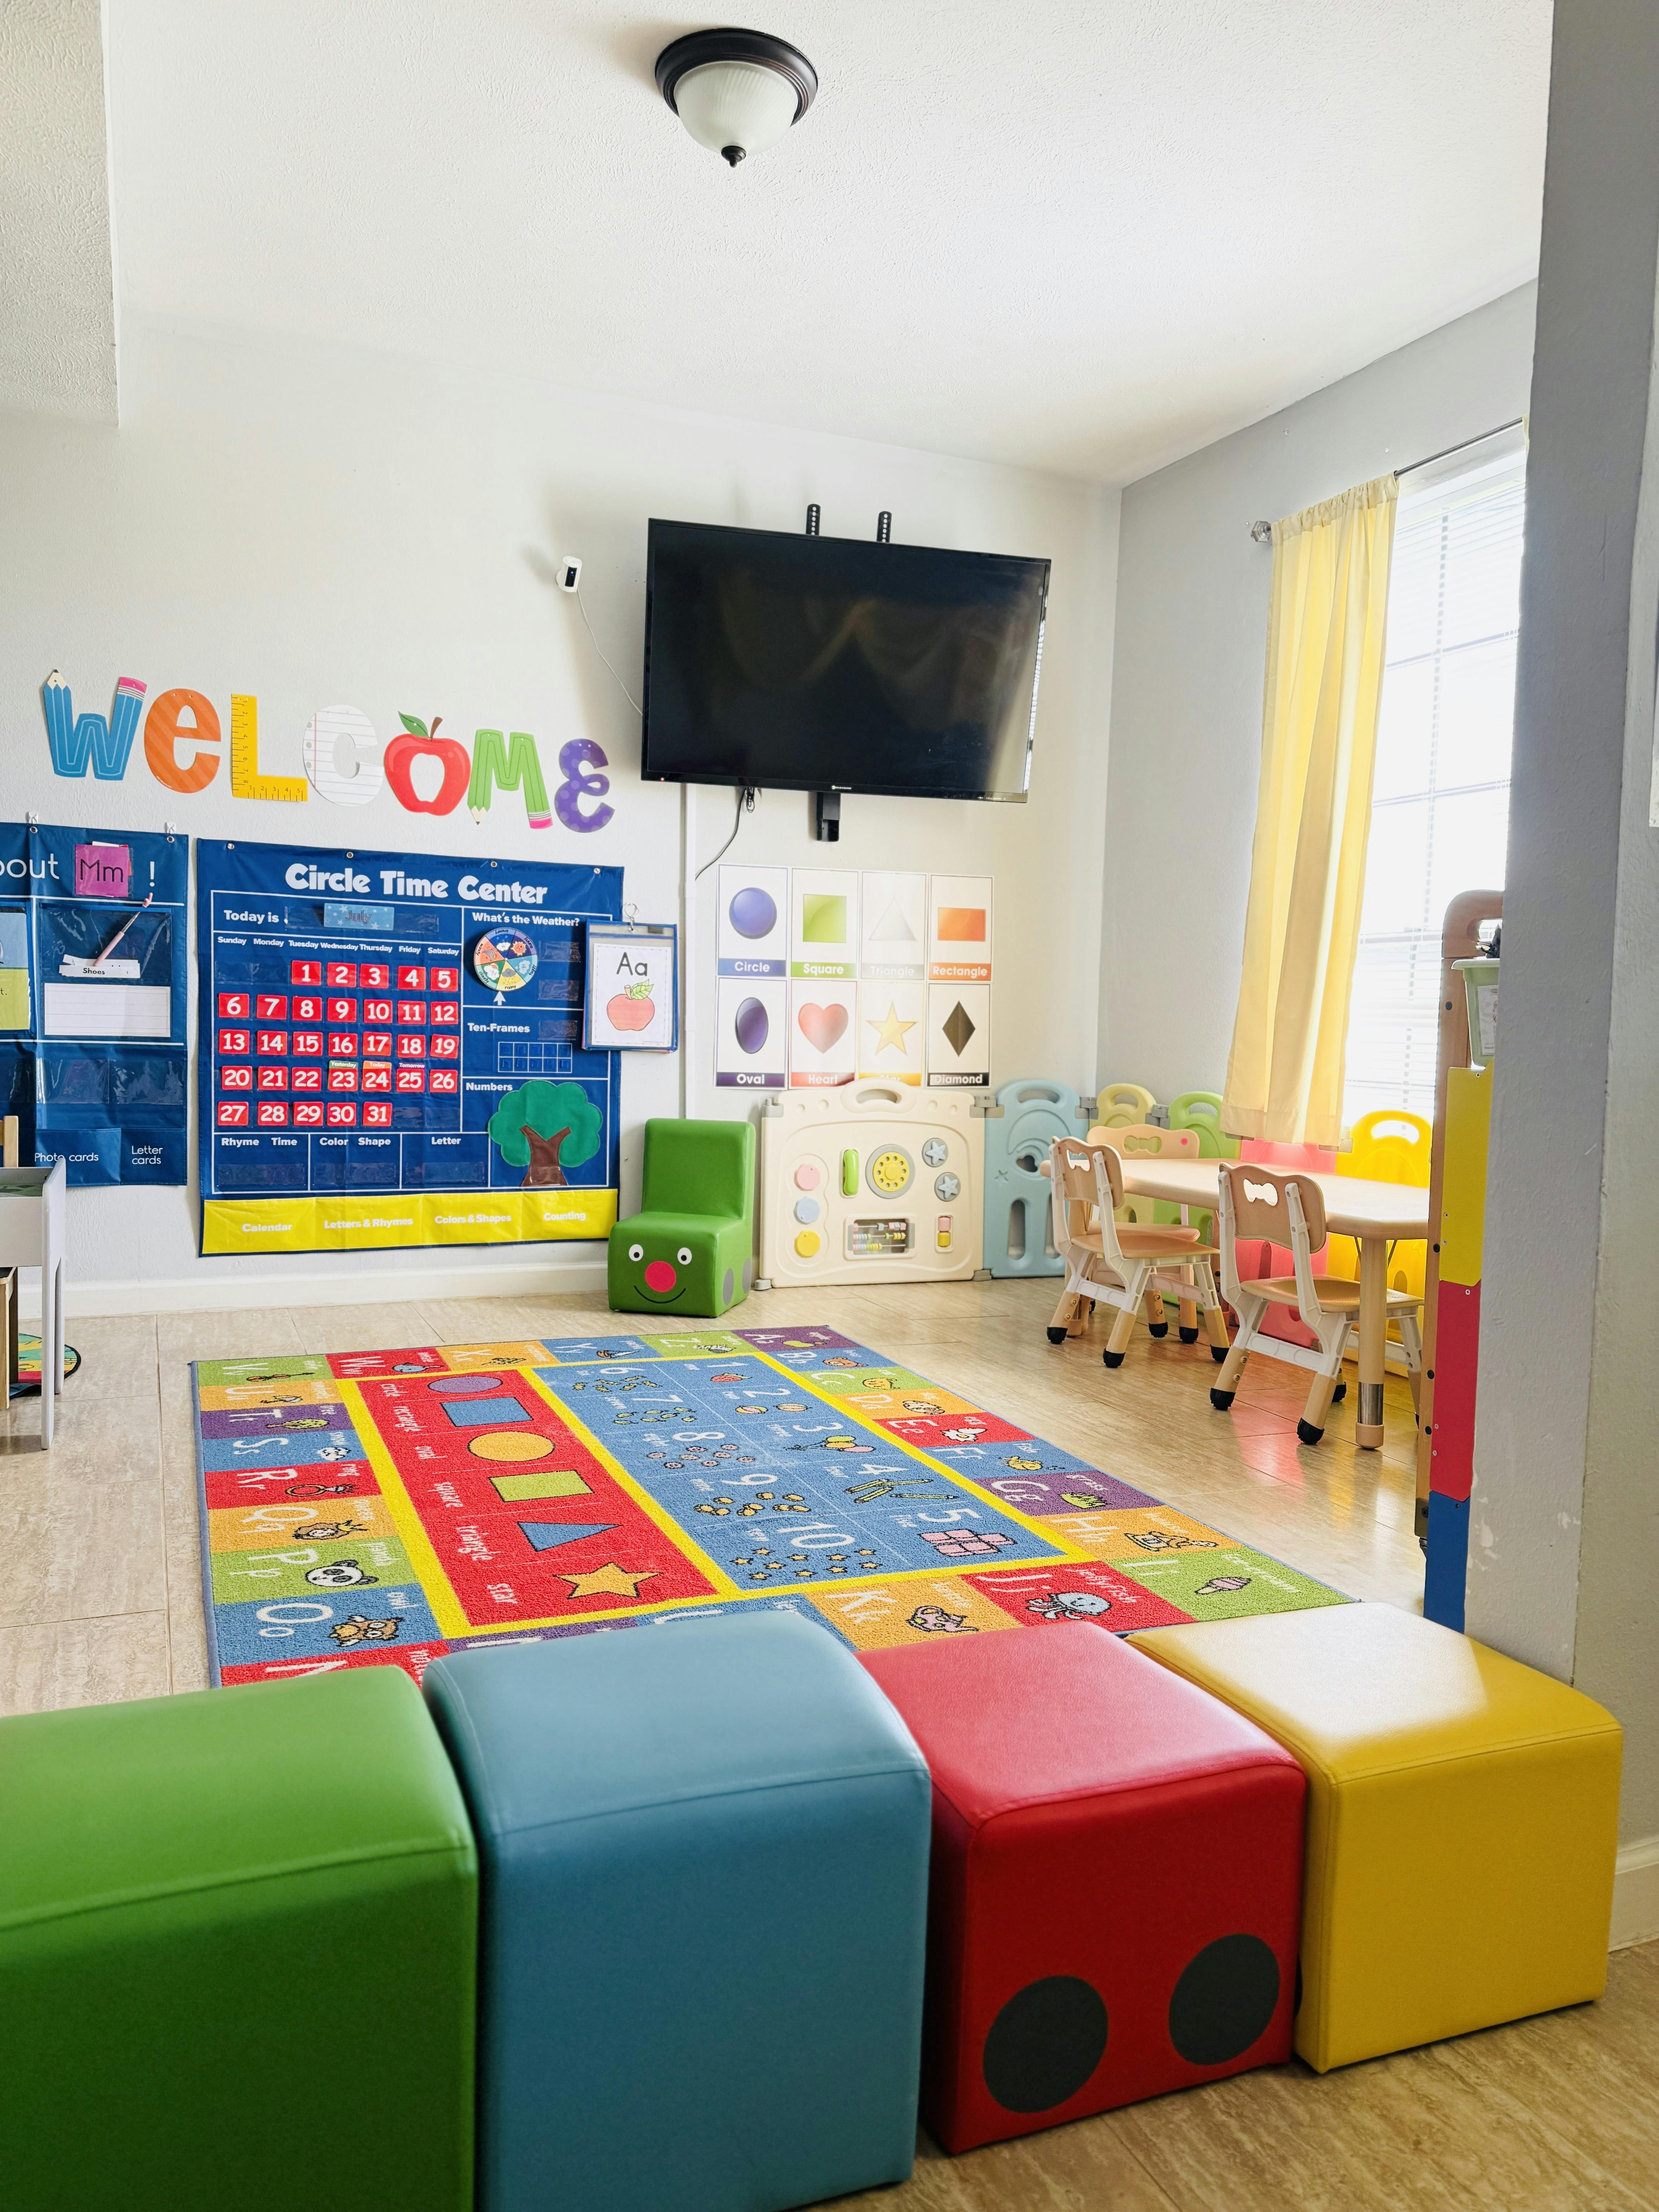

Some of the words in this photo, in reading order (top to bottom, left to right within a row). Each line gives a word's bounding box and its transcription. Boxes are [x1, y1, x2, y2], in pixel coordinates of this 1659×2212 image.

[81, 859, 123, 882] Mm
[285, 864, 370, 893] Circle
[380, 871, 448, 898] Time
[458, 875, 548, 904] Center
[224, 910, 265, 924] Today
[268, 912, 279, 922] is
[345, 910, 372, 924] July
[472, 912, 510, 924] What's
[512, 915, 530, 925] the
[532, 916, 580, 927] Weather?
[218, 936, 246, 945] Sunday
[254, 938, 284, 947] Monday
[289, 940, 319, 949] Tuesday
[320, 943, 358, 951] Wednesday
[359, 944, 392, 953] Thursday
[399, 946, 421, 954] Friday
[428, 947, 459, 956] Saturday
[617, 952, 647, 976] Aa
[735, 962, 770, 972] Circle
[803, 963, 844, 975] Square
[302, 965, 311, 982] 1
[336, 967, 348, 983] 2
[369, 968, 380, 985] 3
[405, 969, 419, 987] 4
[438, 971, 450, 988] 5
[870, 965, 915, 977] Triangle
[933, 965, 988, 978] Rectangle
[227, 997, 241, 1015] 6
[265, 998, 279, 1015] 7
[301, 1000, 313, 1017] 8
[336, 1001, 349, 1018] 9
[368, 1003, 389, 1019] 10
[403, 1005, 421, 1020] 11
[435, 1006, 454, 1021] 12
[467, 1023, 530, 1032] Ten-Frames
[223, 1033, 245, 1050] 13
[261, 1034, 283, 1051] 14
[297, 1036, 318, 1052] 15
[333, 1037, 353, 1053] 16
[368, 1036, 389, 1052] 17
[402, 1038, 421, 1054] 18
[435, 1038, 455, 1054] 19
[225, 1070, 249, 1086] 20
[263, 1070, 283, 1086] 21
[295, 1071, 318, 1087] 22
[333, 1072, 355, 1087] 23
[365, 1072, 388, 1087] 24
[399, 1072, 421, 1088] 25
[433, 1073, 454, 1089] 26
[737, 1073, 765, 1084] Oval
[808, 1074, 838, 1084] Heart
[934, 1075, 982, 1085] Diamond
[466, 1082, 512, 1091] Numbers
[221, 1106, 246, 1121] 27
[261, 1106, 284, 1121] 28
[297, 1106, 320, 1122] 29
[330, 1106, 354, 1122] 30
[368, 1106, 387, 1121] 31
[222, 1138, 259, 1147] Rhyme
[359, 1137, 391, 1147] Shape
[132, 1146, 163, 1154] Letter
[35, 1153, 65, 1163] Photo
[69, 1152, 98, 1161] cards
[132, 1156, 161, 1164] cards
[467, 1215, 476, 1223] &
[476, 1214, 511, 1224] Shapes
[543, 1211, 586, 1221] Counting
[242, 1223, 292, 1232] Calendar
[324, 1221, 362, 1229] Letters
[363, 1219, 370, 1227] &
[372, 1219, 413, 1228] Rhymes
[659, 1338, 704, 1348] Zz
[745, 1334, 785, 1344] Aa
[554, 1343, 597, 1353] Yy
[451, 1349, 493, 1362] Xx
[777, 1351, 817, 1364] Bb
[223, 1363, 269, 1375] Vv
[338, 1356, 386, 1374] Ww
[811, 1372, 855, 1385] Cc
[225, 1385, 275, 1400] Uu
[380, 1384, 408, 1397] circle
[743, 1388, 790, 1398] 2
[848, 1394, 894, 1409] Dd
[229, 1409, 283, 1422] Tt
[320, 1405, 336, 1415] tree
[393, 1406, 428, 1432] rectangle
[964, 1417, 987, 1425] egg
[767, 1424, 792, 1437] three
[793, 1422, 843, 1432] 3
[887, 1419, 939, 1434] Ee
[329, 1432, 347, 1445] snow
[672, 1432, 725, 1441] 8
[233, 1438, 289, 1455] Ss
[414, 1446, 446, 1459] oval
[932, 1447, 988, 1459] Ff
[1013, 1443, 1041, 1453] fish
[338, 1464, 363, 1476] ring
[823, 1466, 849, 1478] four
[856, 1464, 909, 1475] 4
[237, 1468, 298, 1489] Rr
[721, 1474, 778, 1485] 9
[1066, 1475, 1109, 1491] grass
[428, 1482, 463, 1508] square
[991, 1480, 1051, 1501] Gg
[348, 1498, 375, 1521] queen
[917, 1508, 981, 1522] 5
[239, 1507, 318, 1534] Qq
[889, 1515, 918, 1528] five
[777, 1522, 855, 1549] 10
[1050, 1516, 1120, 1543] Hh
[456, 1525, 501, 1561] triangle
[357, 1542, 400, 1566] panda
[229, 1548, 319, 1578] Pp
[1121, 1560, 1180, 1576] Ii
[1221, 1553, 1301, 1593] ice-cream
[975, 1573, 1053, 1592] Jj
[1065, 1568, 1142, 1603] jellyfish
[487, 1583, 518, 1604] star
[386, 1592, 421, 1609] owl
[825, 1590, 897, 1624] Kk
[256, 1603, 334, 1637] Oo
